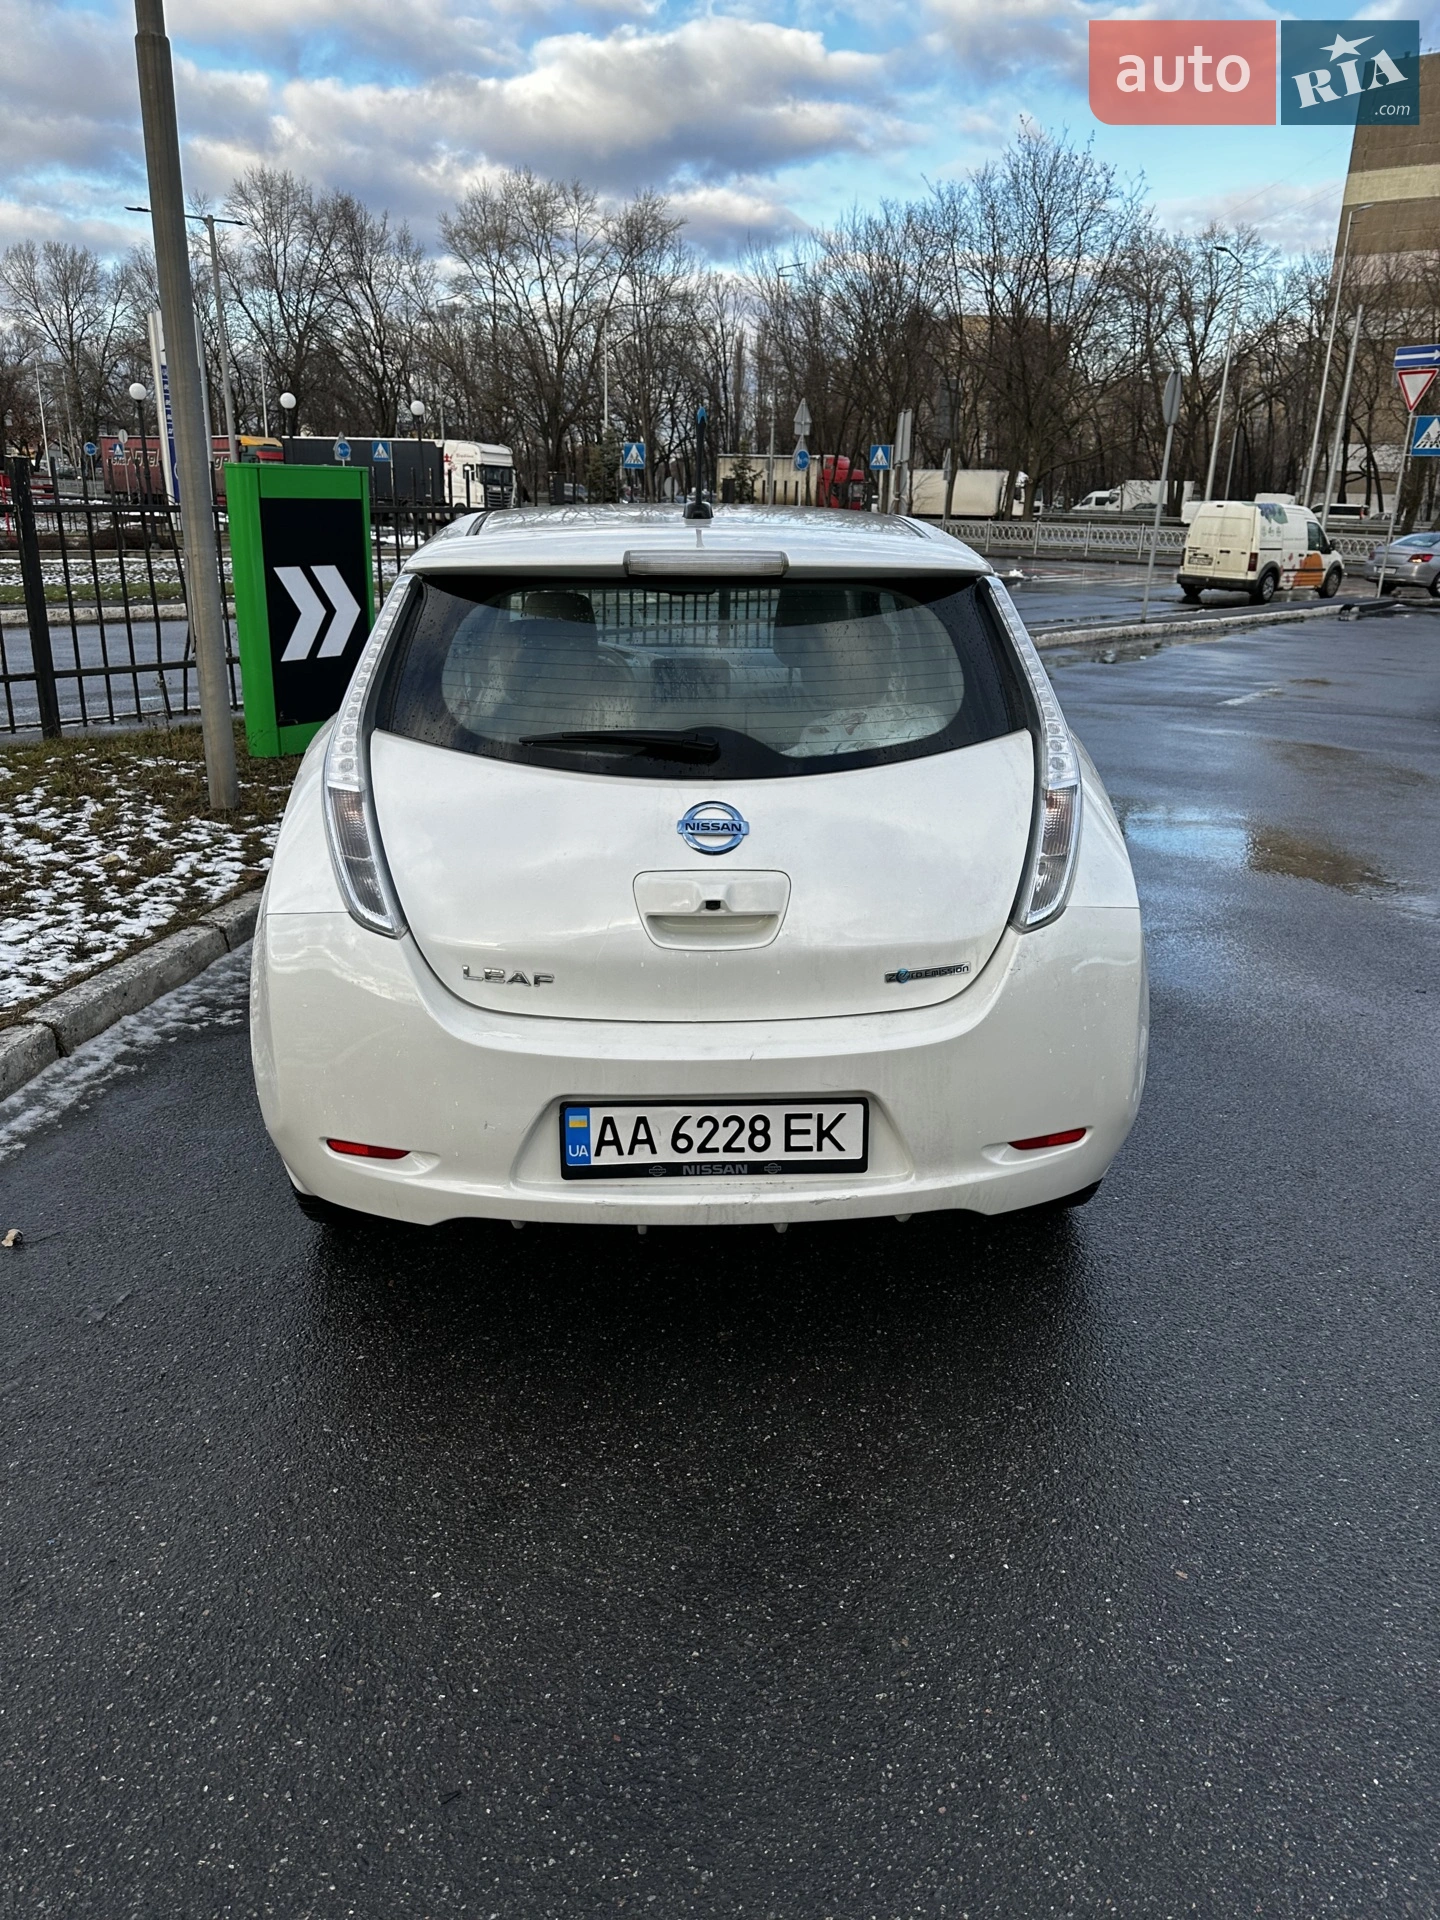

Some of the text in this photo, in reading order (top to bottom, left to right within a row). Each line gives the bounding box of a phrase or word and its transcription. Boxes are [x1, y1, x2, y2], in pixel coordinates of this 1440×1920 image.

[685, 822, 742, 832] NISSAN
[462, 965, 555, 987] LEAF
[594, 1113, 847, 1157] AA 6228 EK
[569, 1145, 588, 1158] UA
[682, 1164, 748, 1176] NISSAN
